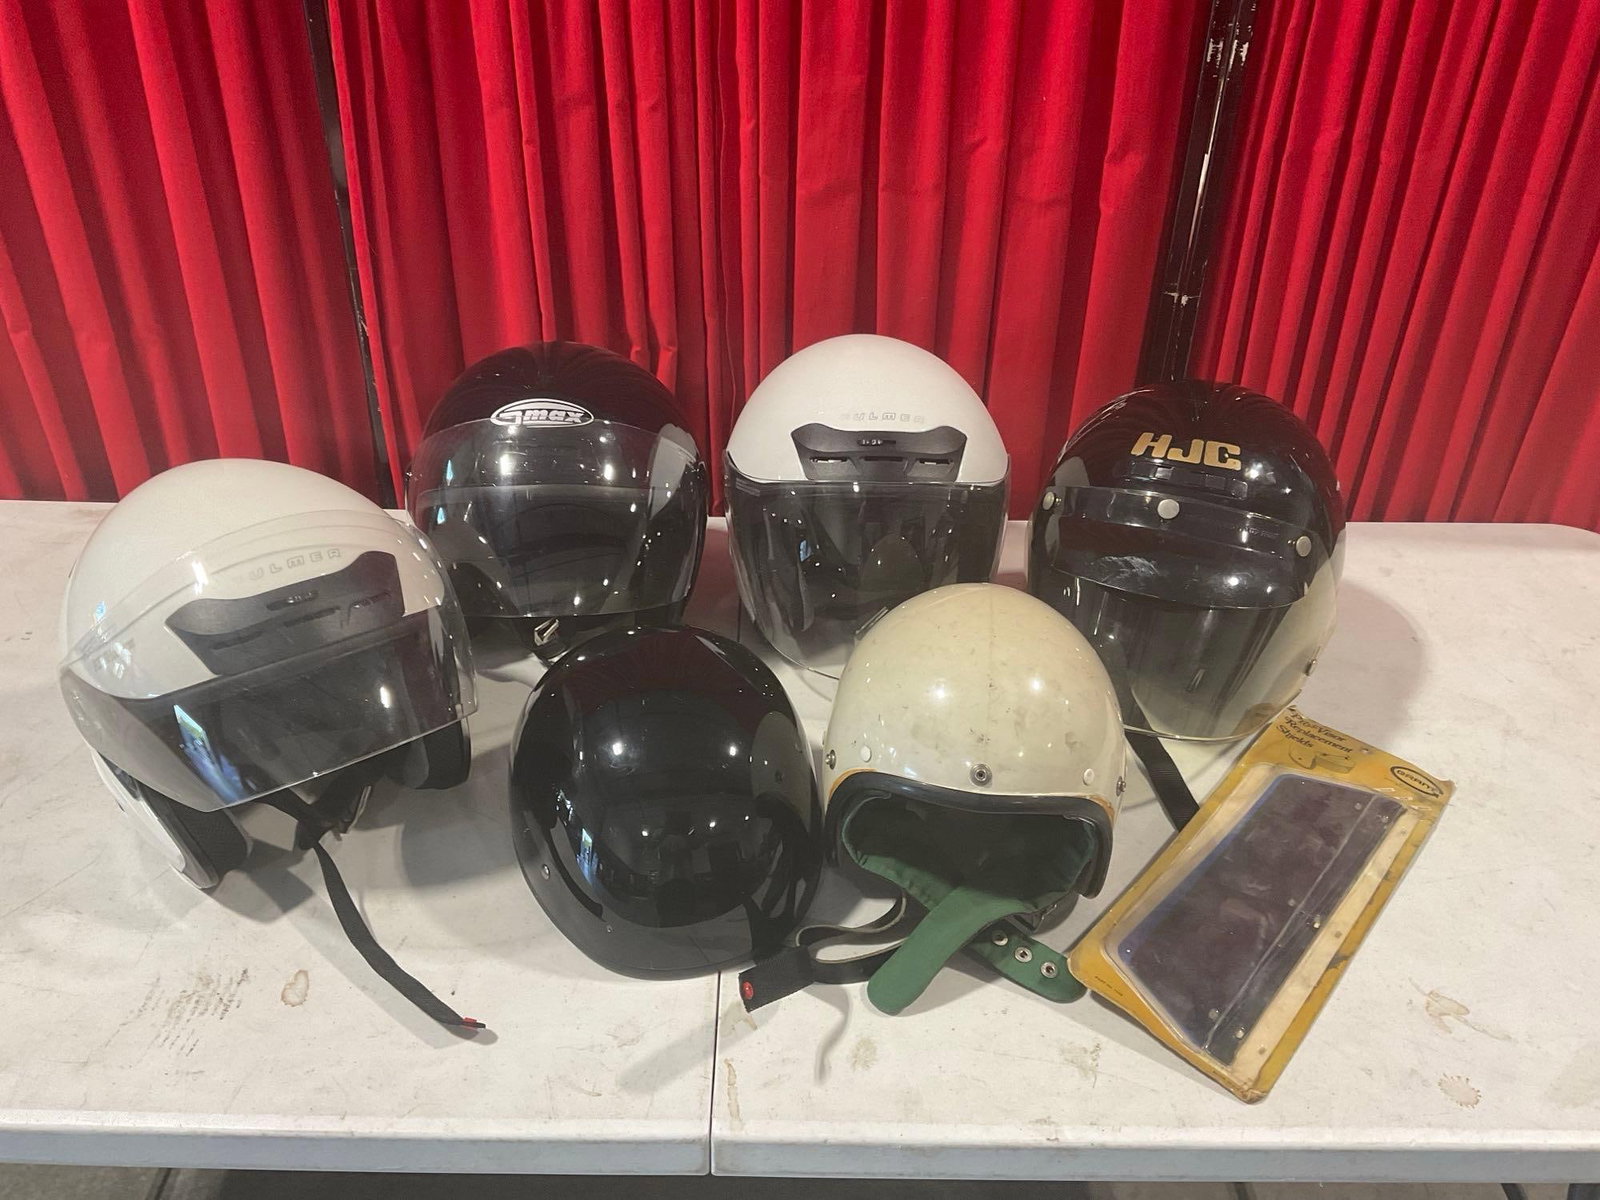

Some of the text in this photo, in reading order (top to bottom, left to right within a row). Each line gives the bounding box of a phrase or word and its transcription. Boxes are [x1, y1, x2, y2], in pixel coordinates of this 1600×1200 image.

[839, 411, 925, 424] ULMER
[1130, 432, 1242, 472] HJC
[238, 548, 341, 580] ULMER
[1276, 724, 1314, 748] Shields
[1284, 716, 1353, 753] Replacement
